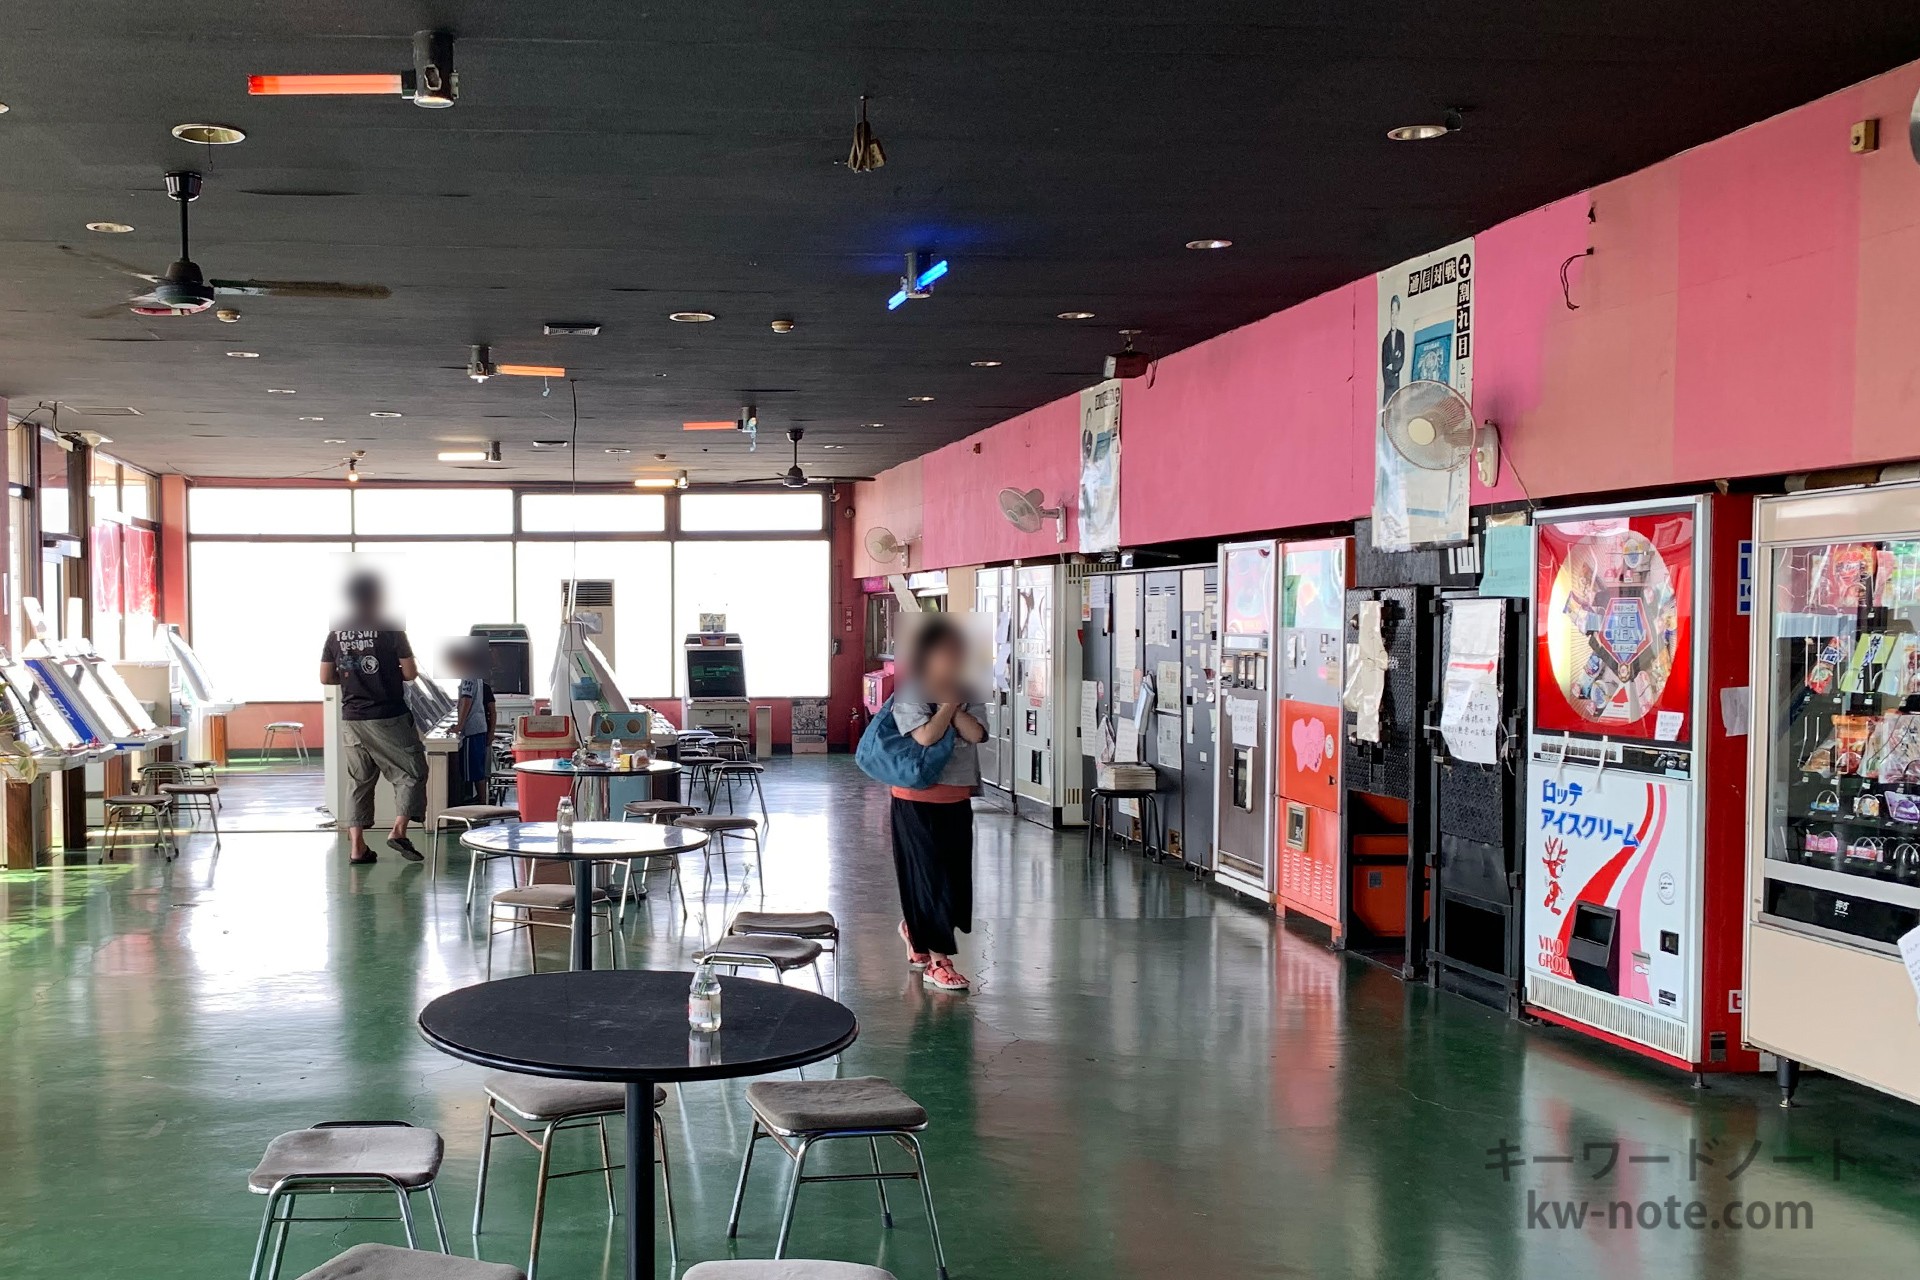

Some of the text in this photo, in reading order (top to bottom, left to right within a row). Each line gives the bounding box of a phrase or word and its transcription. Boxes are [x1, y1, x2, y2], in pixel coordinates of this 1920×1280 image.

[1408, 258, 1457, 296] 通信対戦
[1613, 615, 1636, 628] ICE
[340, 639, 374, 651] Designs
[1603, 629, 1647, 642] CREAM
[1542, 778, 1583, 806] ロッテ
[1540, 808, 1641, 848] アイスクリーム
[1538, 934, 1564, 956] VIVO
